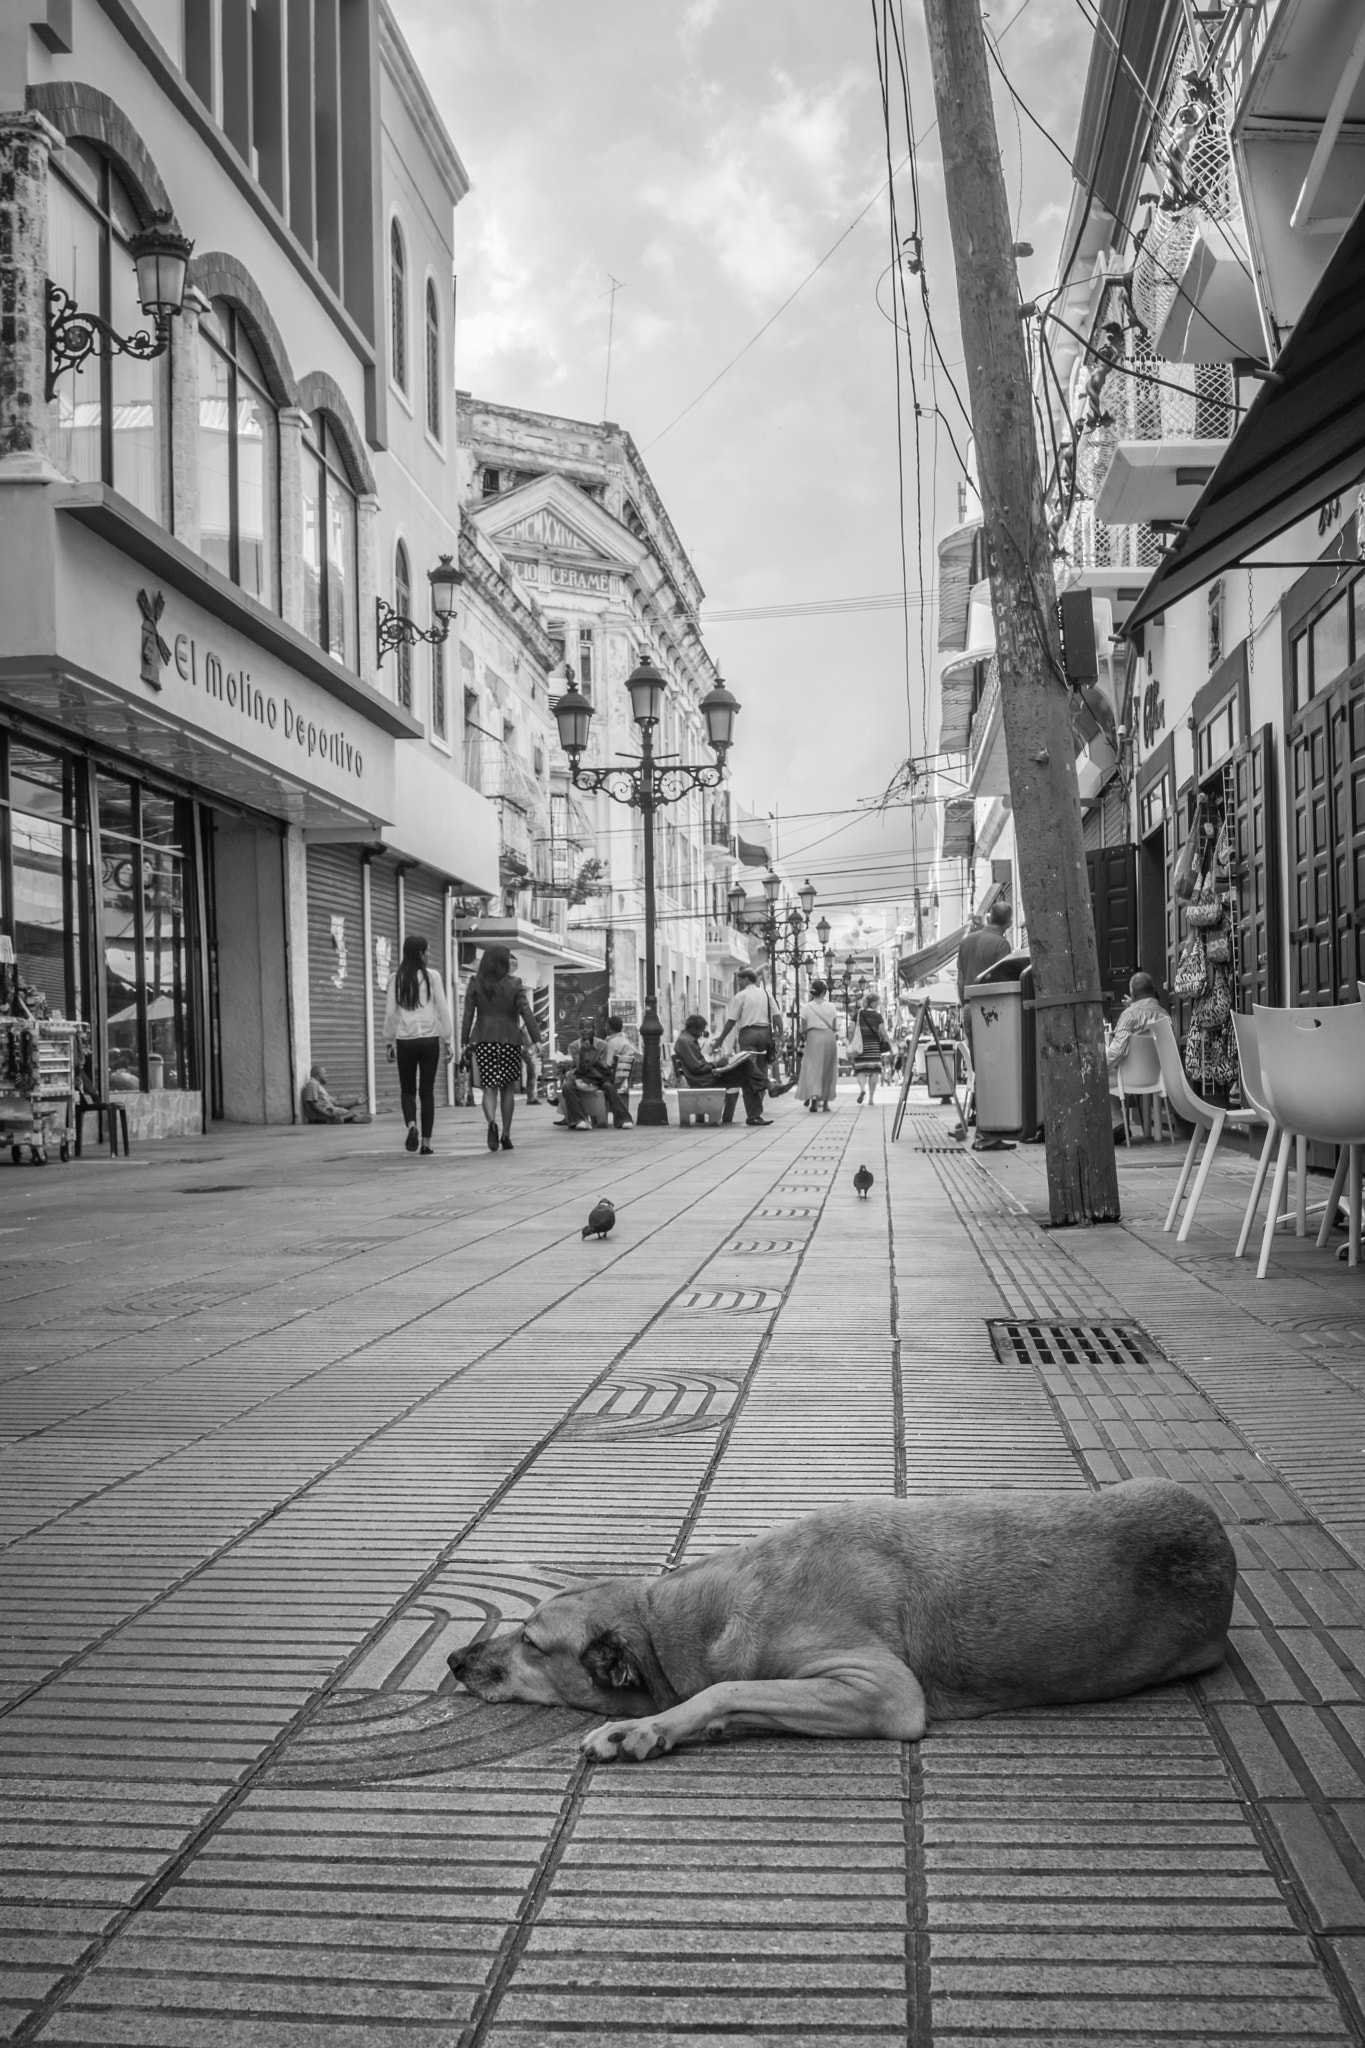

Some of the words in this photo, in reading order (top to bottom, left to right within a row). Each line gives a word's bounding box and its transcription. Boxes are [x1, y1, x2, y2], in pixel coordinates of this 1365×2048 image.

[516, 510, 573, 548] MCMXXIV
[551, 567, 609, 592] CERAME
[174, 633, 196, 686] El
[205, 651, 278, 730] Molino
[283, 698, 364, 778] Deportivo
